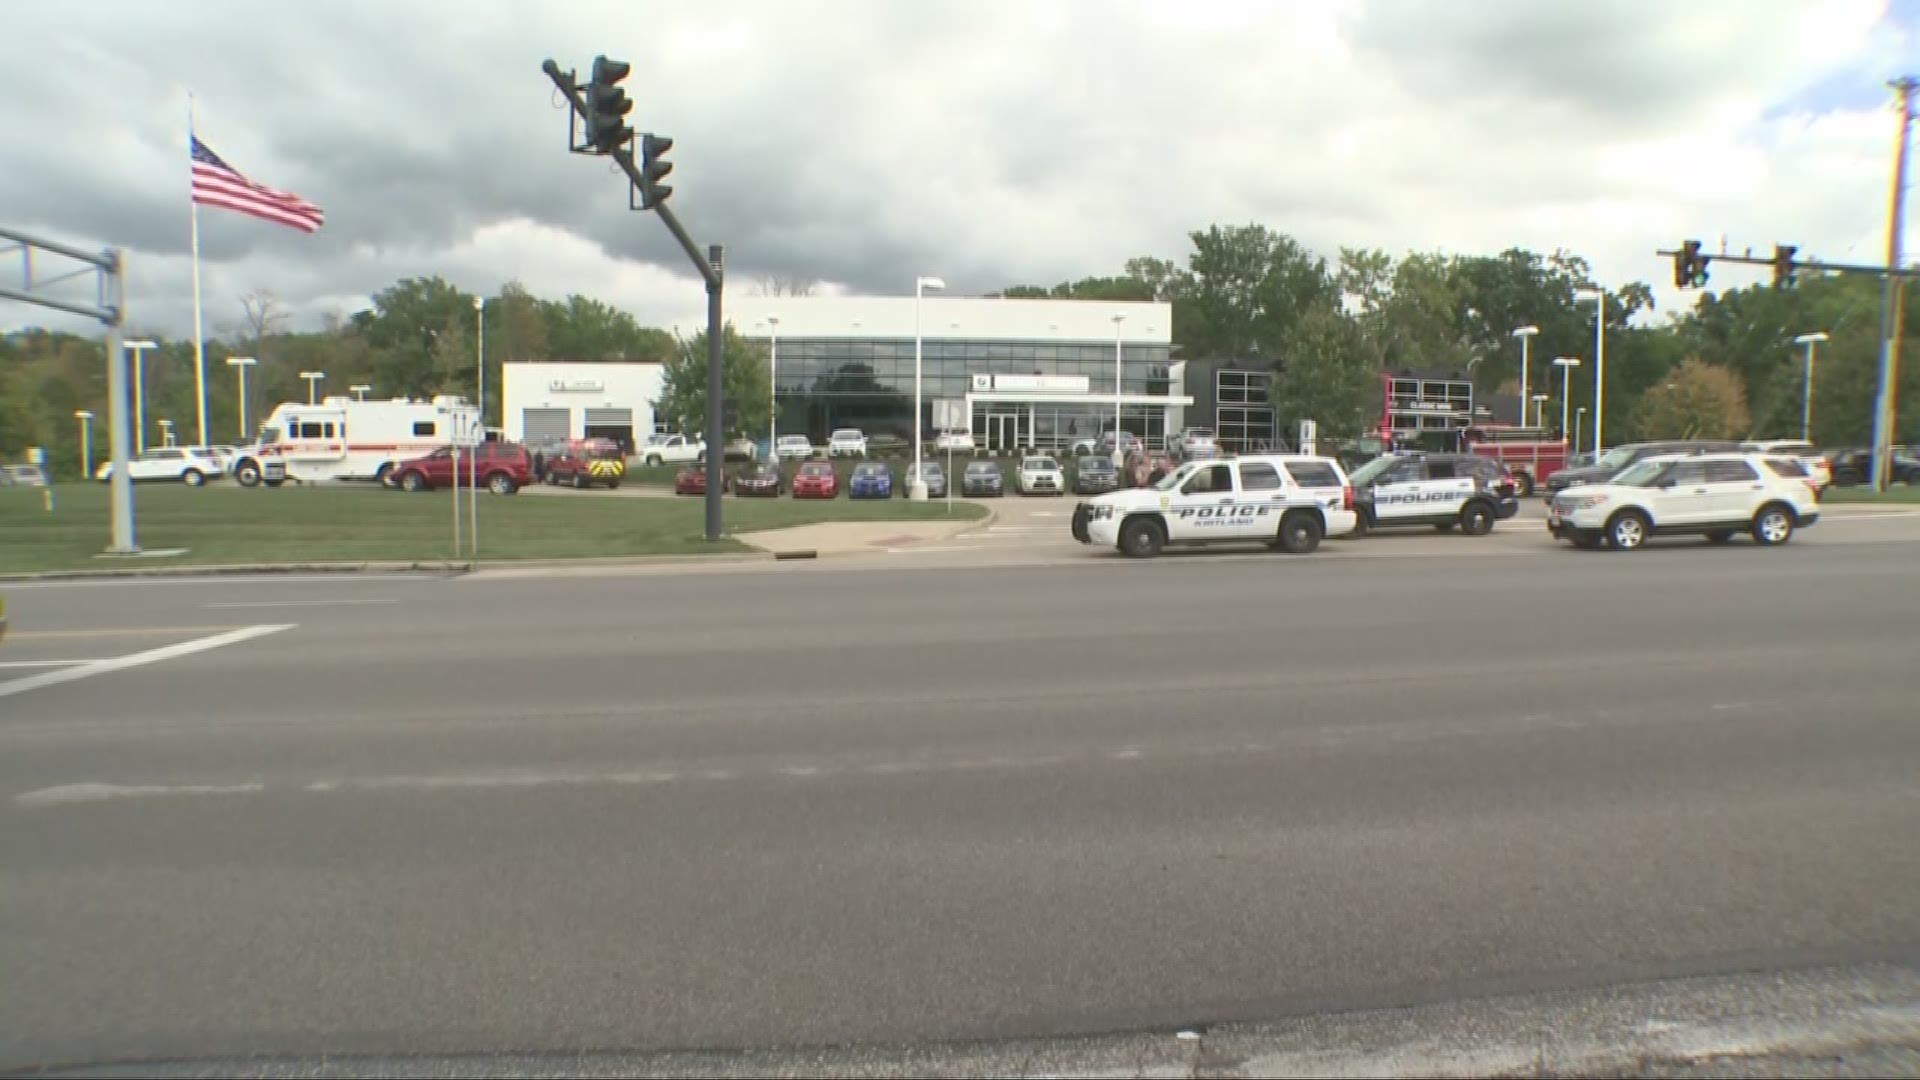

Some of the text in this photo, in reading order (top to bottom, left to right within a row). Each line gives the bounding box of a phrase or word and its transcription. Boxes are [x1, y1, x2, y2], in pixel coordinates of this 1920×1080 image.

[1389, 491, 1455, 504] POLICE
[1179, 505, 1271, 518] POLICE
[1193, 517, 1254, 527] KIRTLAND
